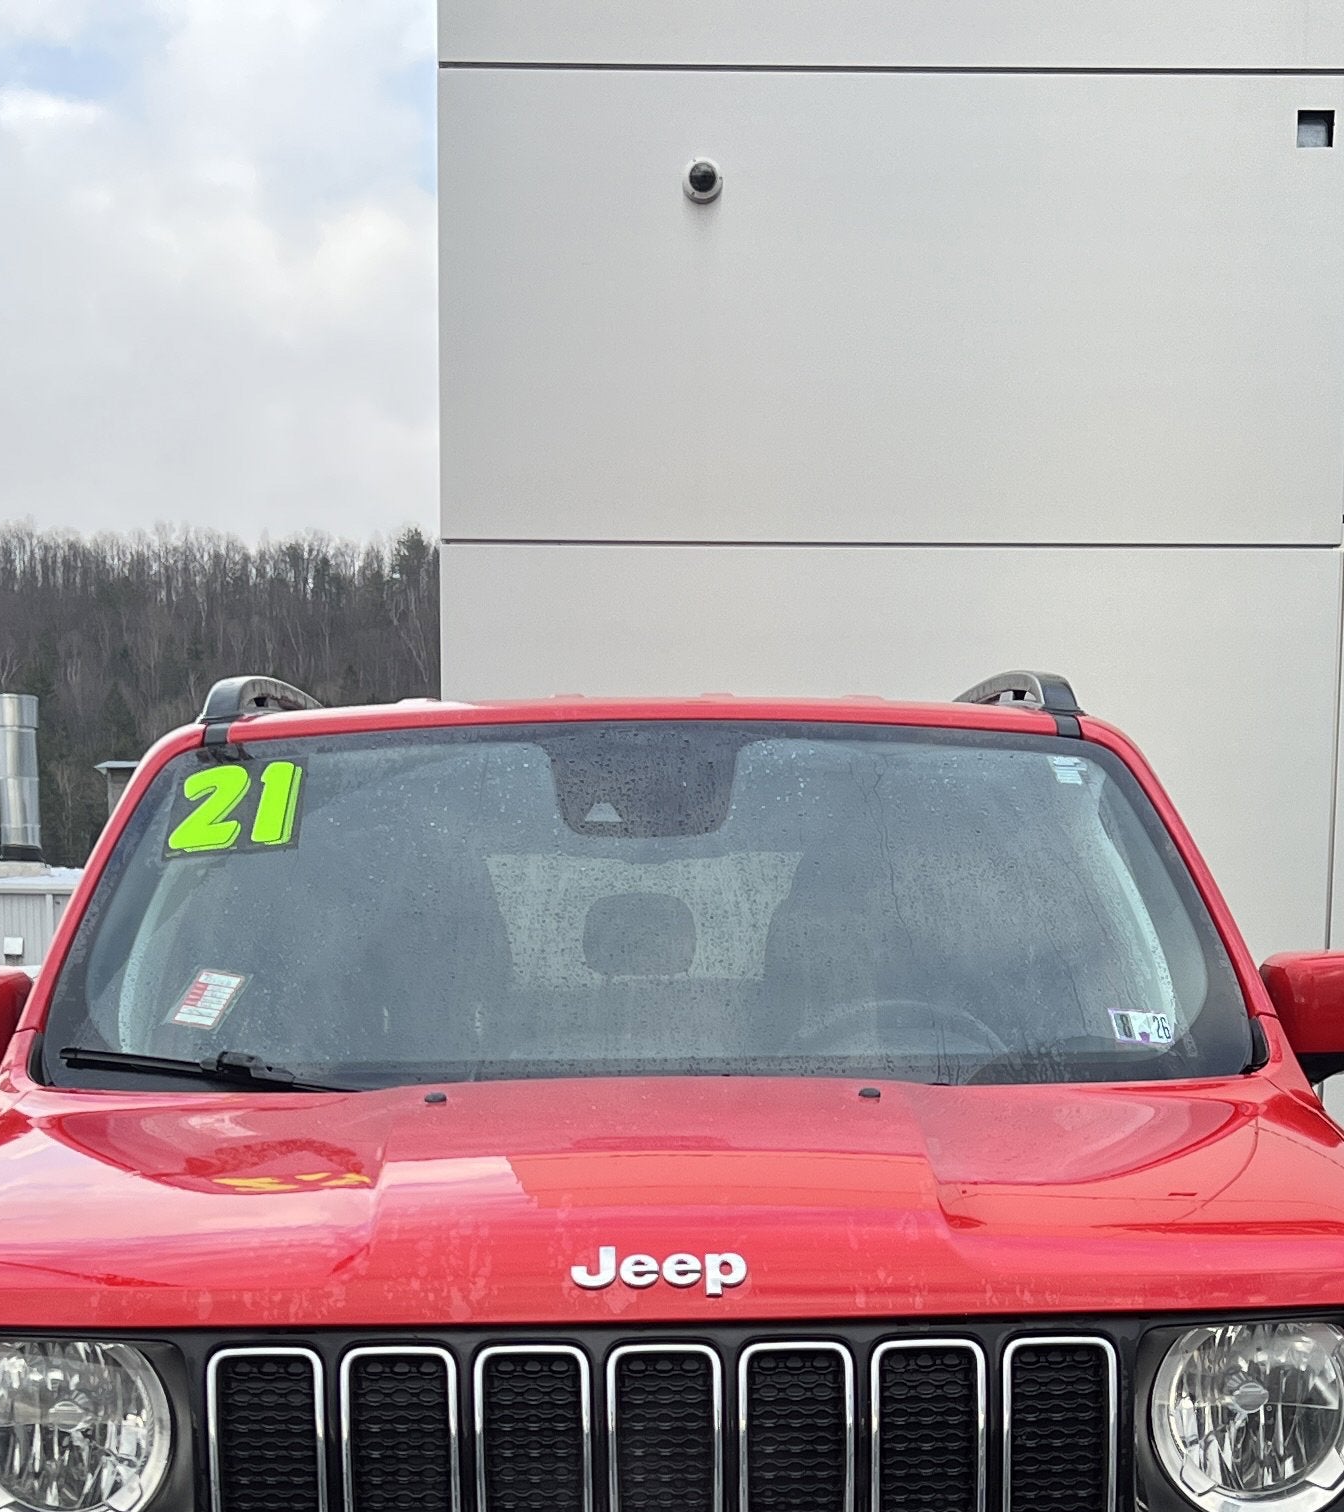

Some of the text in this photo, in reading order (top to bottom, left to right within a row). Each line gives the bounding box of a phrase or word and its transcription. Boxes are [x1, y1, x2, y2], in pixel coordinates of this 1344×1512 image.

[168, 761, 303, 853] 21
[1152, 1015, 1171, 1039] 26
[570, 1245, 748, 1297] Jeep
